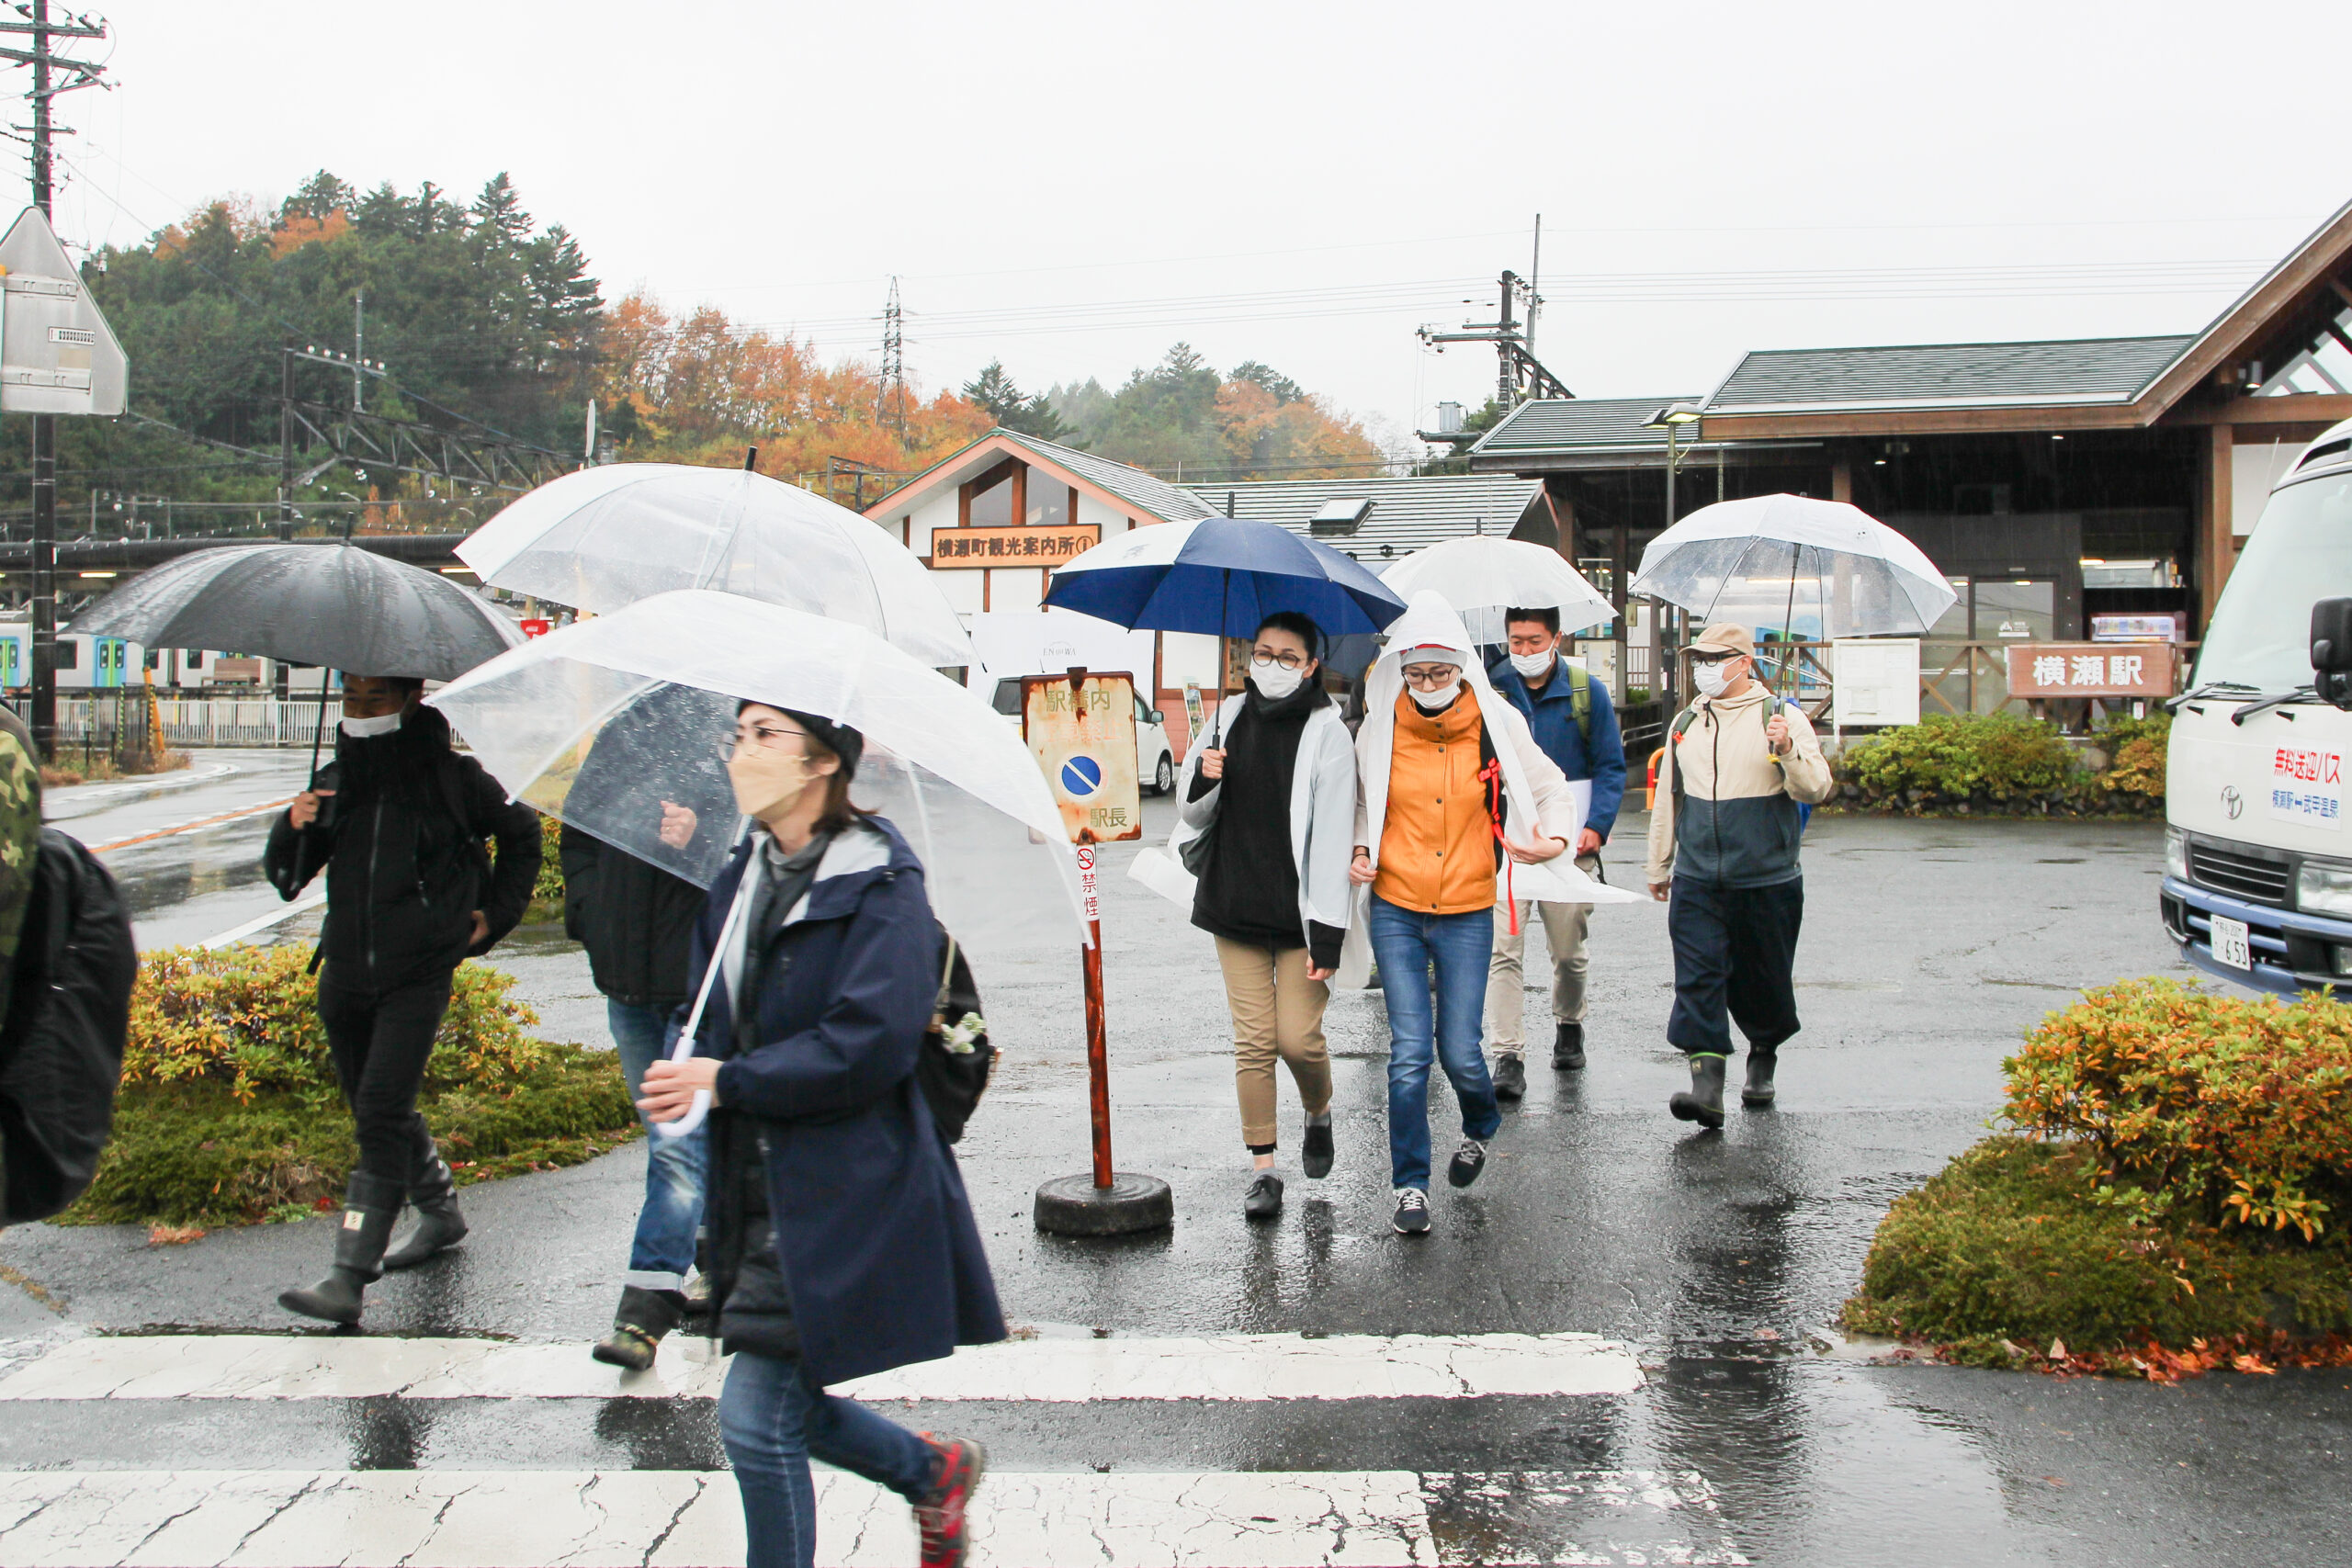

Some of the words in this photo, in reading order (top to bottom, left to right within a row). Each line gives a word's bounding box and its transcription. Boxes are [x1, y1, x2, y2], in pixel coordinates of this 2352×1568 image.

[937, 536, 1075, 558] 横瀬町観光案内所
[2032, 655, 2144, 687] 横瀬駅
[1046, 689, 1111, 713] 駅構内
[2273, 748, 2341, 785] 無料送迎バス
[1090, 807, 1128, 829] 駅長
[1081, 873, 1099, 917] 禁煙
